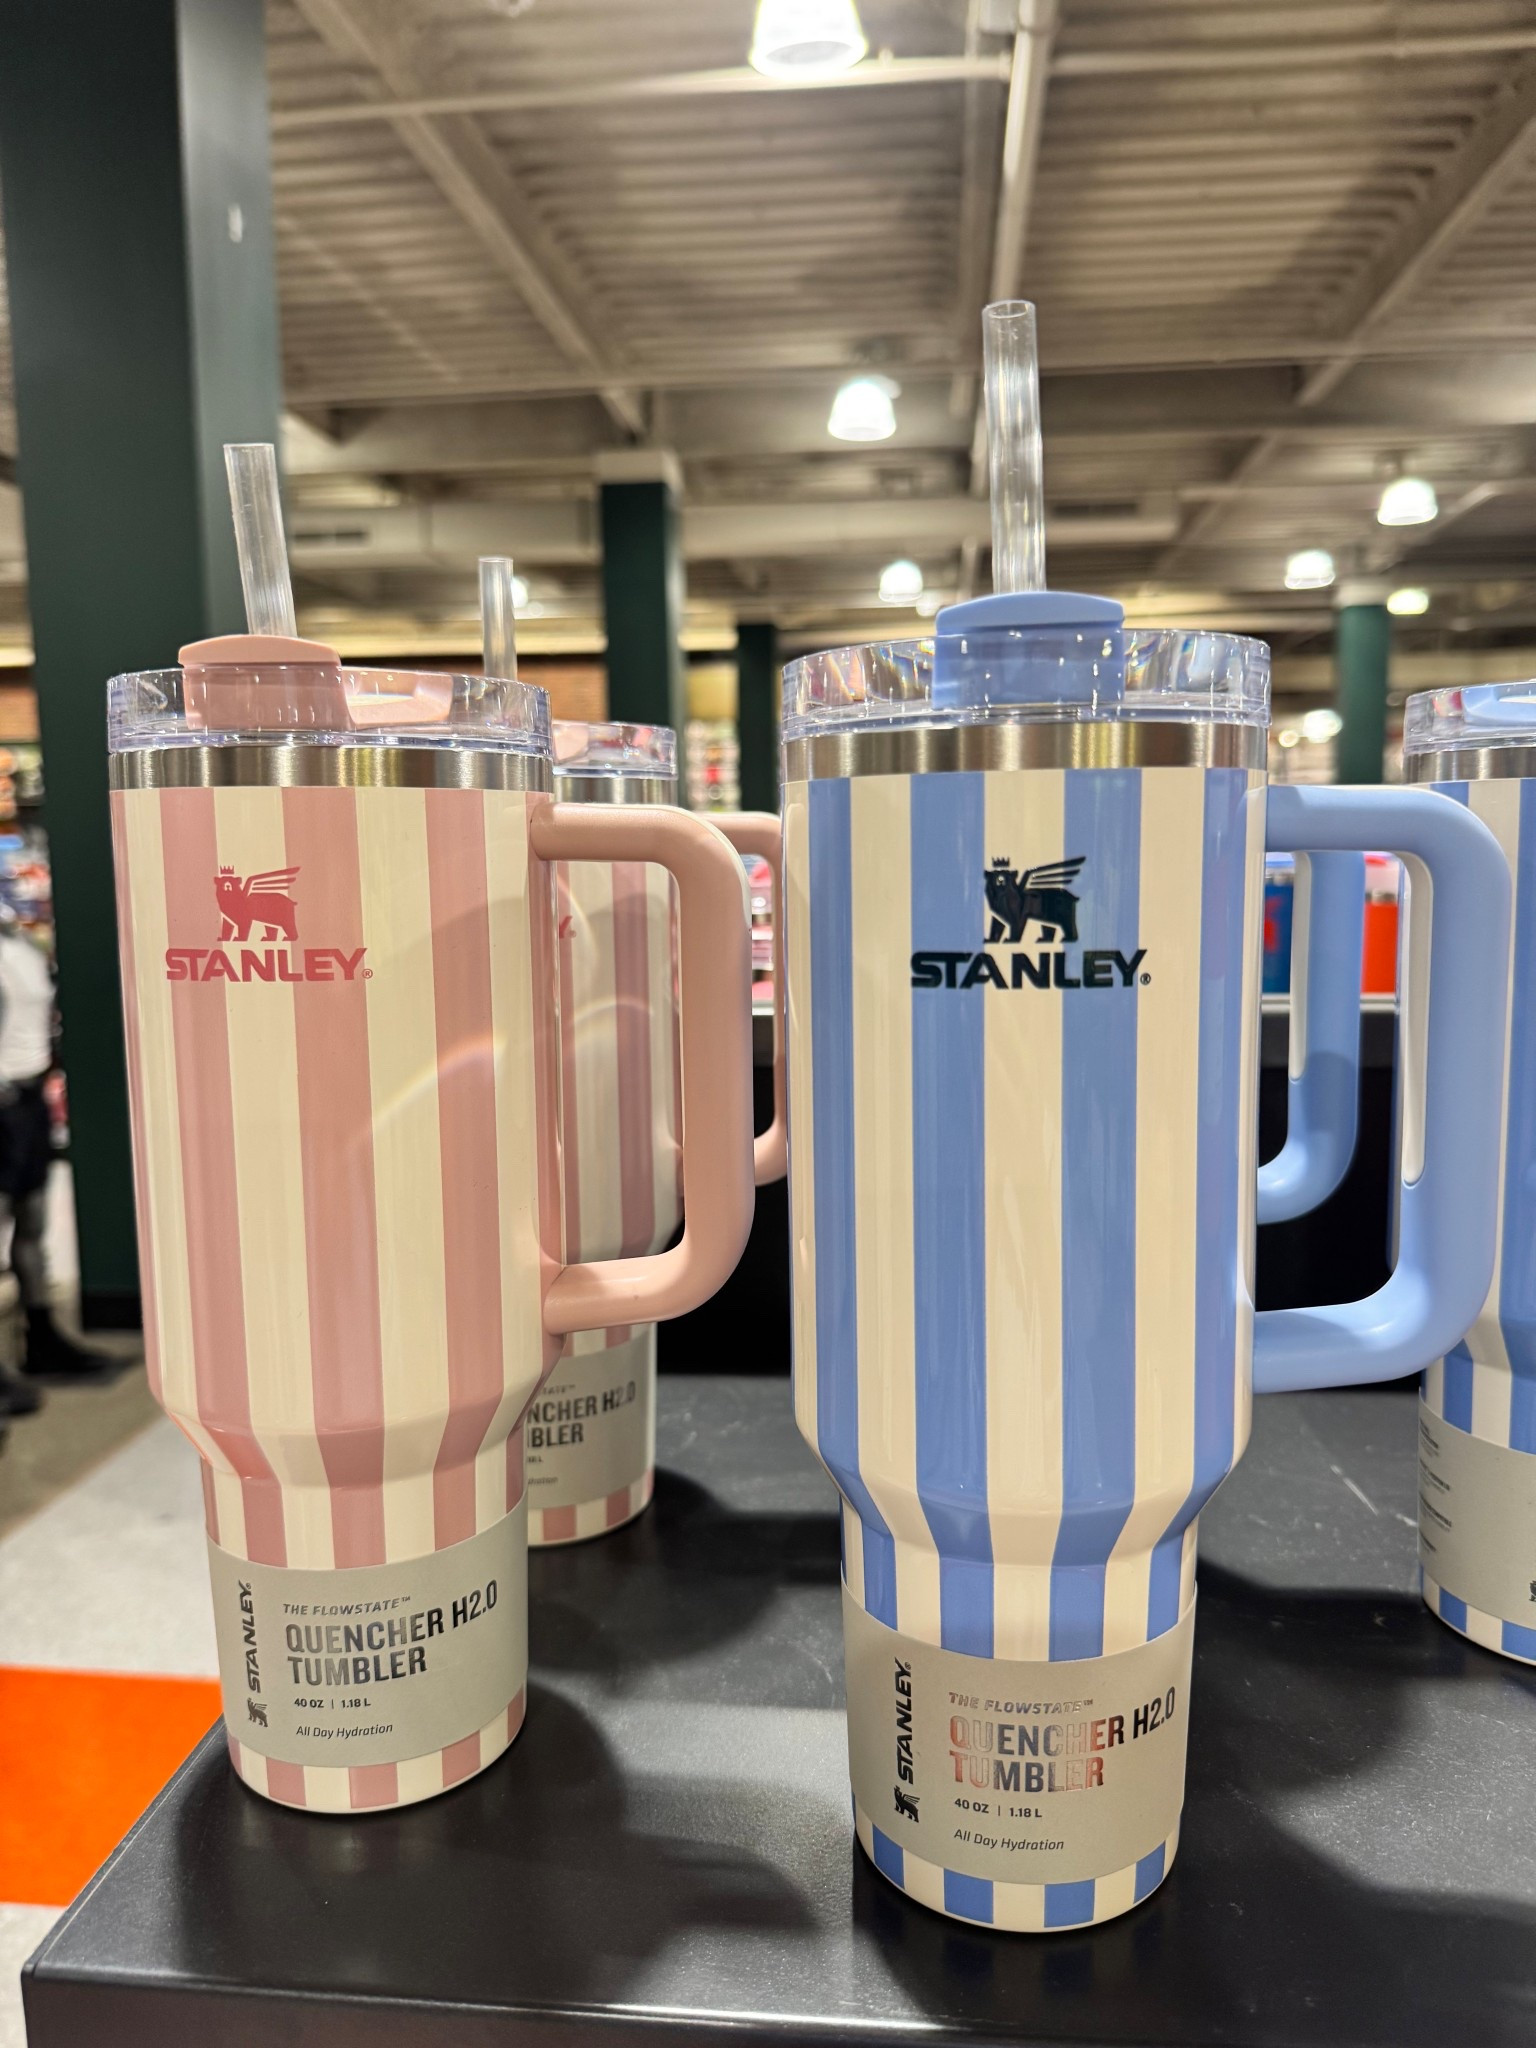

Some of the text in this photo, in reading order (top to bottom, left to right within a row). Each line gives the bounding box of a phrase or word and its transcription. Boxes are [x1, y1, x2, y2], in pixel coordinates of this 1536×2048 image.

[527, 1395, 598, 1424] NCHER
[527, 1422, 584, 1448] BLER
[283, 1603, 308, 1616] THE
[285, 1579, 498, 1654] QUENCHER H2.0
[287, 1645, 428, 1686] TUMBLER
[294, 1698, 307, 1708] 40
[309, 1699, 324, 1709] OZ
[341, 1698, 362, 1709] 1.18
[364, 1698, 371, 1707] L
[948, 1691, 980, 1710] THE
[296, 1723, 393, 1740] All Day Hydration
[950, 1686, 1176, 1757] QUENCHER H2.0
[949, 1749, 1104, 1793] TUMBLER
[954, 1798, 970, 1810] 40
[972, 1802, 989, 1814] OZ
[1009, 1807, 1032, 1818] 1.18
[1034, 1808, 1042, 1818] L
[953, 1828, 1064, 1852] All Day Hydration
